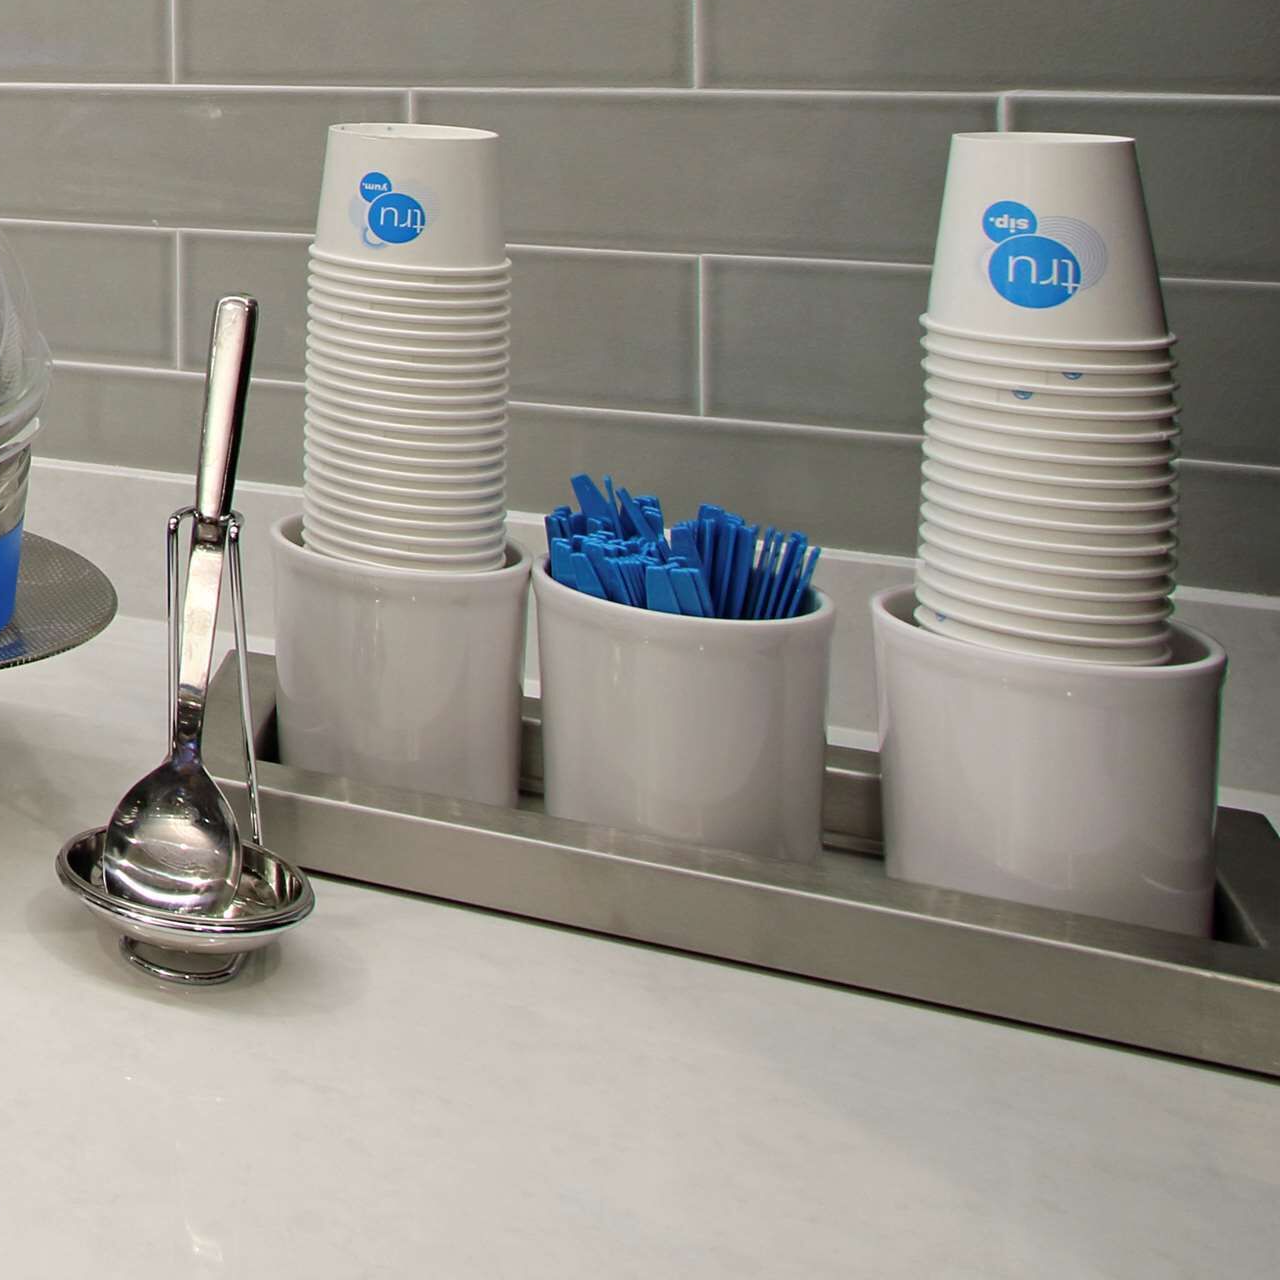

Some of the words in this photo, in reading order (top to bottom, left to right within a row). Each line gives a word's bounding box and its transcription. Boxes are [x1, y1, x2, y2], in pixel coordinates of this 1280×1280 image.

[362, 181, 389, 192] yum.
[379, 206, 425, 234] tru
[989, 214, 1030, 233] sip.
[1007, 255, 1081, 295] tru
